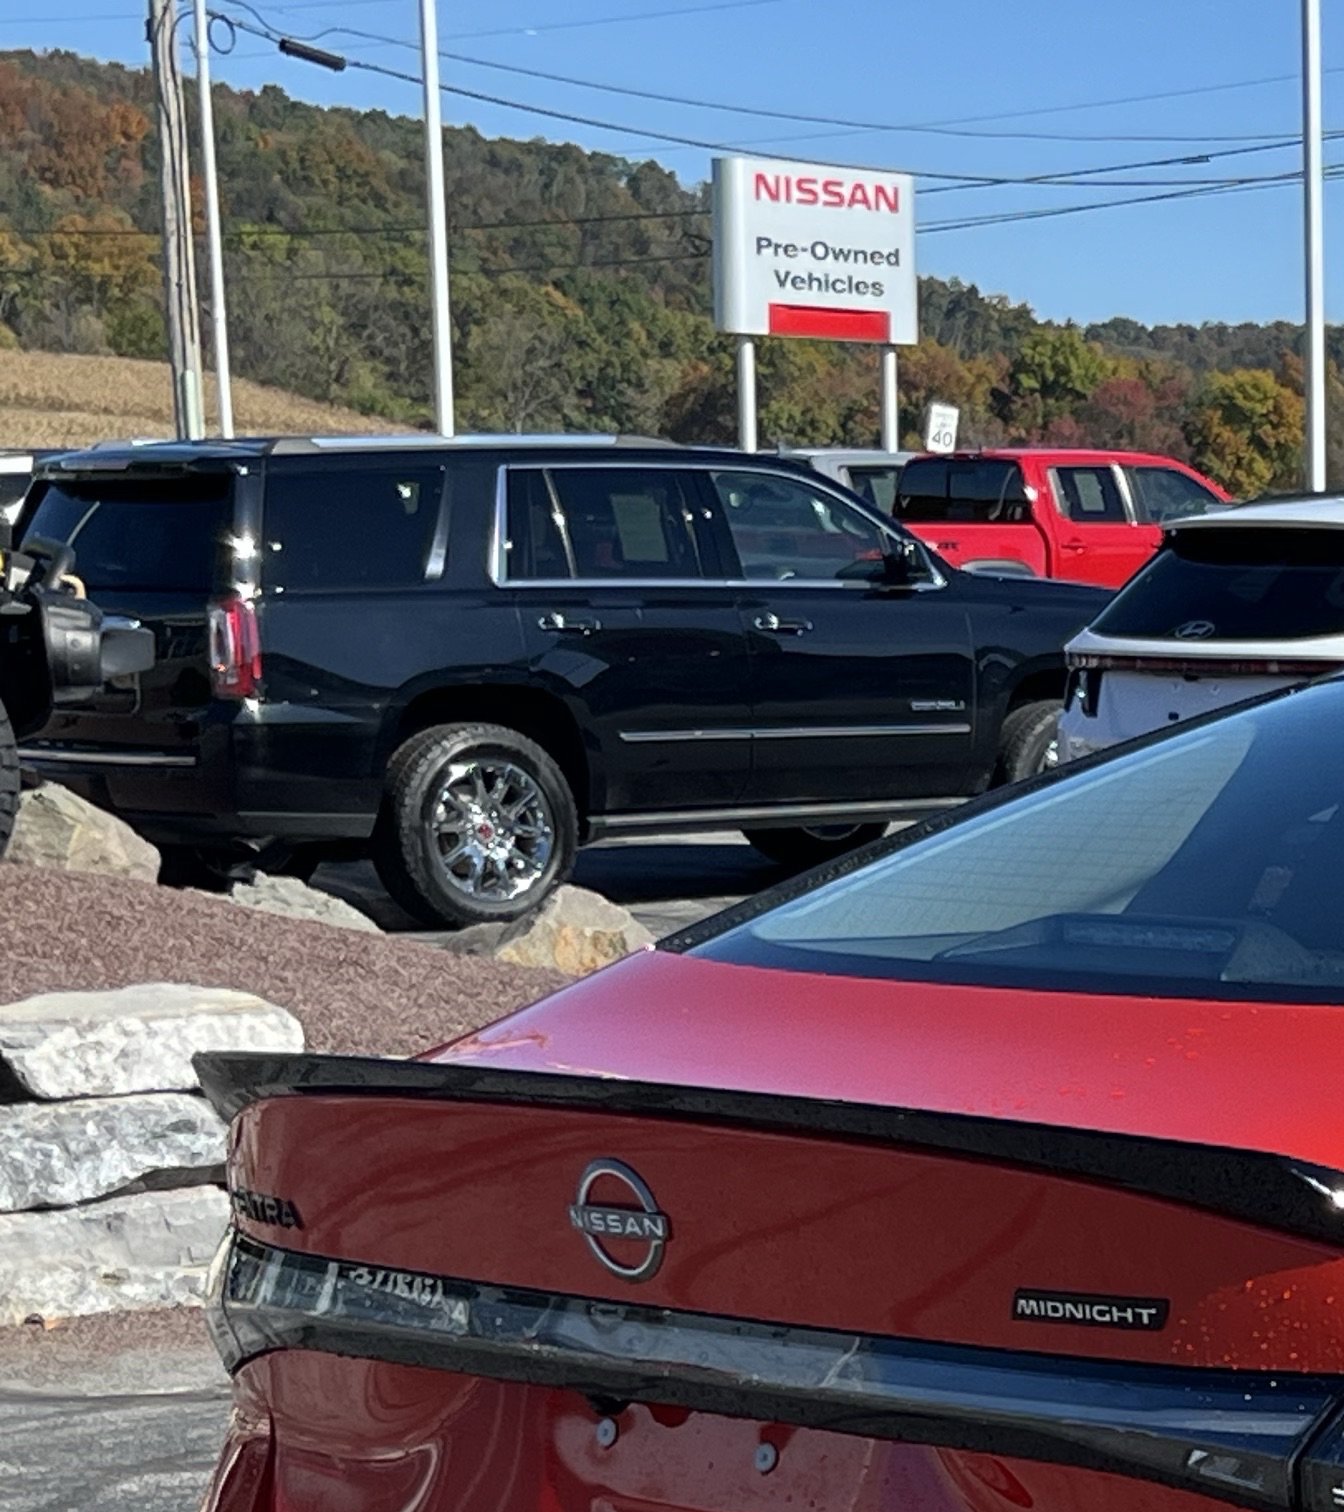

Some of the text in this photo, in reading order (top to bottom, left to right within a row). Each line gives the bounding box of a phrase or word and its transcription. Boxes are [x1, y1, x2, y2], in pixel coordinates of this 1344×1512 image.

[755, 173, 899, 213] NISSAN
[756, 236, 900, 266] Pre-Owned
[774, 269, 885, 297] Vehicles
[931, 430, 953, 448] 40
[569, 1209, 664, 1237] NISSAN
[1016, 1298, 1157, 1325] MIDNIGHT
